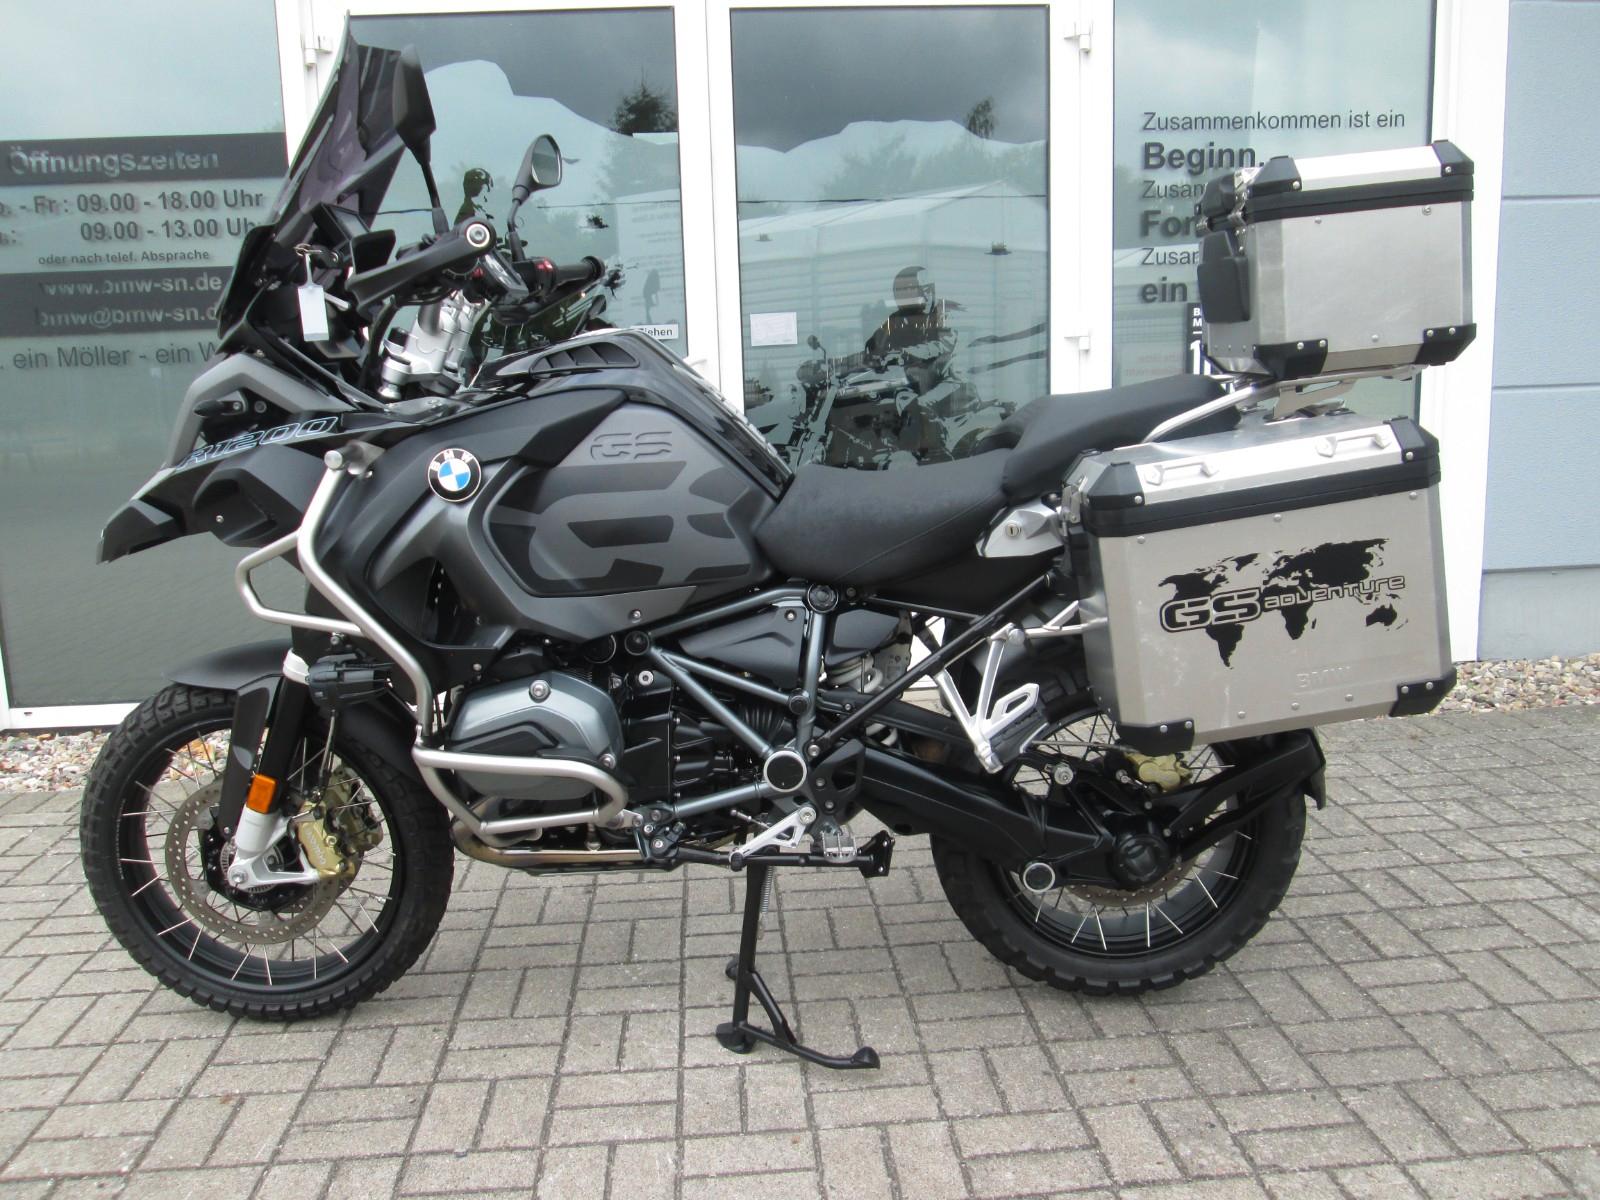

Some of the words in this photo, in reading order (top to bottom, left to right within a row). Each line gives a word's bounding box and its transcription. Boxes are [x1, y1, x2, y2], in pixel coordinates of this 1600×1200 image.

[1142, 111, 1341, 131] Zusammenkommen
[1349, 110, 1370, 128] ist
[1377, 110, 1405, 128] ein
[10, 147, 219, 177] Öffnungszeiten
[1143, 142, 1265, 175] Beginn.
[76, 192, 135, 213] 09.00
[157, 190, 215, 210] 18.00
[223, 188, 264, 209] Uhr
[80, 221, 138, 241] 09.00
[161, 218, 219, 239] 13.00
[38, 253, 66, 265] oder
[71, 251, 102, 264] nach
[141, 249, 210, 264] Absprache
[1141, 276, 1188, 303] ein
[13, 347, 48, 369] ein
[57, 345, 130, 368] Möller
[155, 343, 192, 364] ein
[590, 431, 672, 460] GS
[1159, 587, 1264, 633] GS
